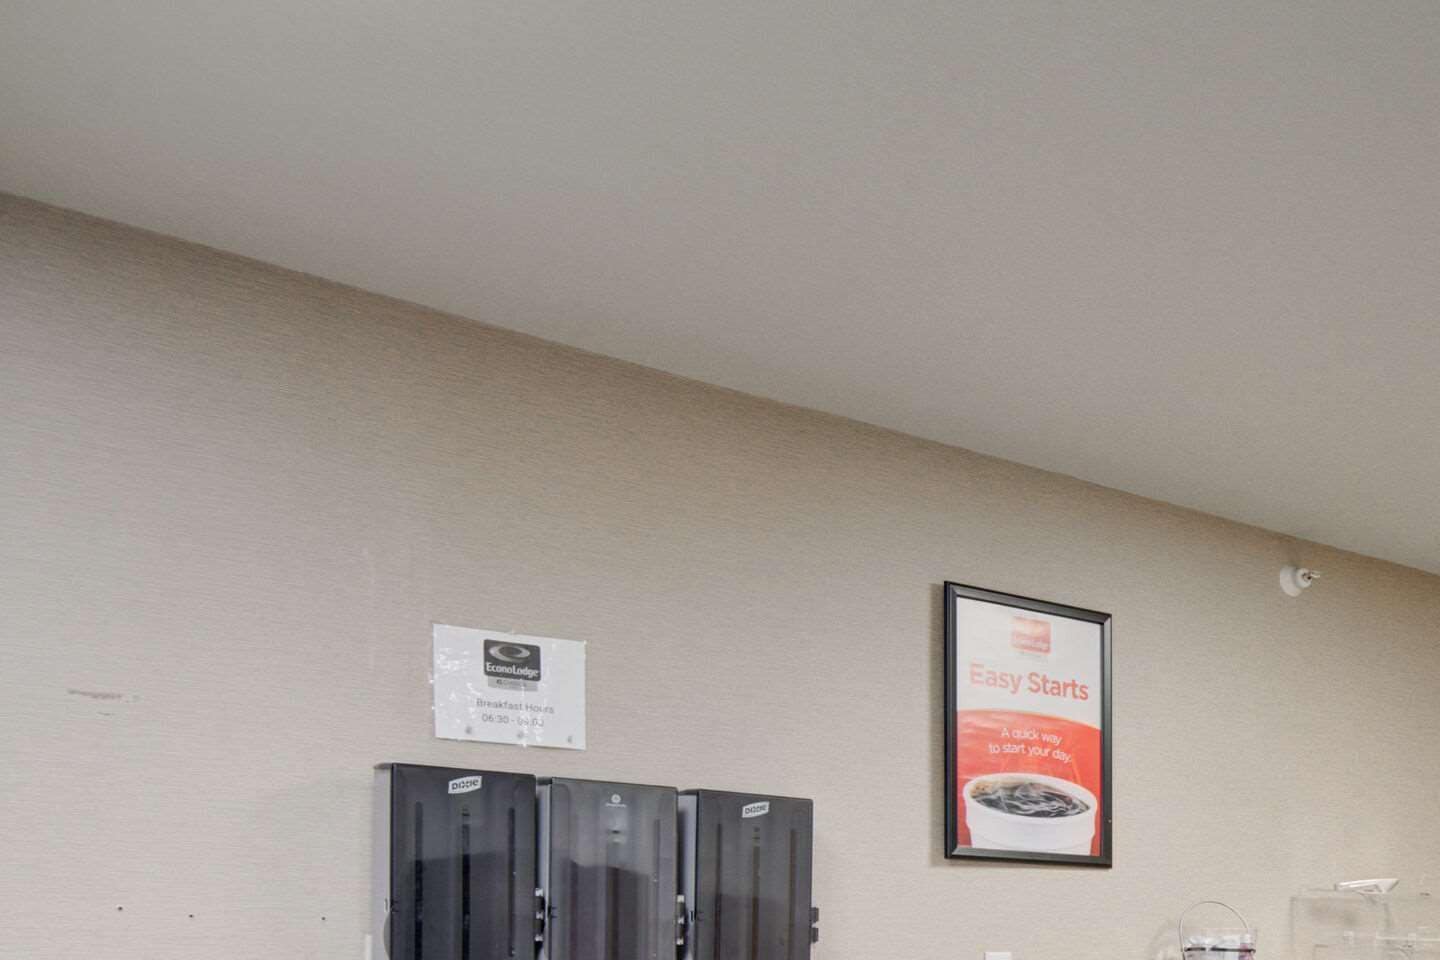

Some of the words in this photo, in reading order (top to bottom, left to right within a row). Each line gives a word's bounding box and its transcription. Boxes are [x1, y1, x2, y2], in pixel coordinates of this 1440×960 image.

[970, 662, 1022, 694] Easy
[1027, 671, 1088, 700] Starts
[476, 698, 522, 711] Breakfast
[525, 702, 554, 714] Hours
[481, 713, 510, 724] 06:30
[1001, 727, 1010, 739] A
[1011, 727, 1039, 741] quick
[1040, 732, 1063, 746] way
[988, 743, 1001, 754] to
[1002, 742, 1025, 755] start
[1026, 744, 1051, 759] your
